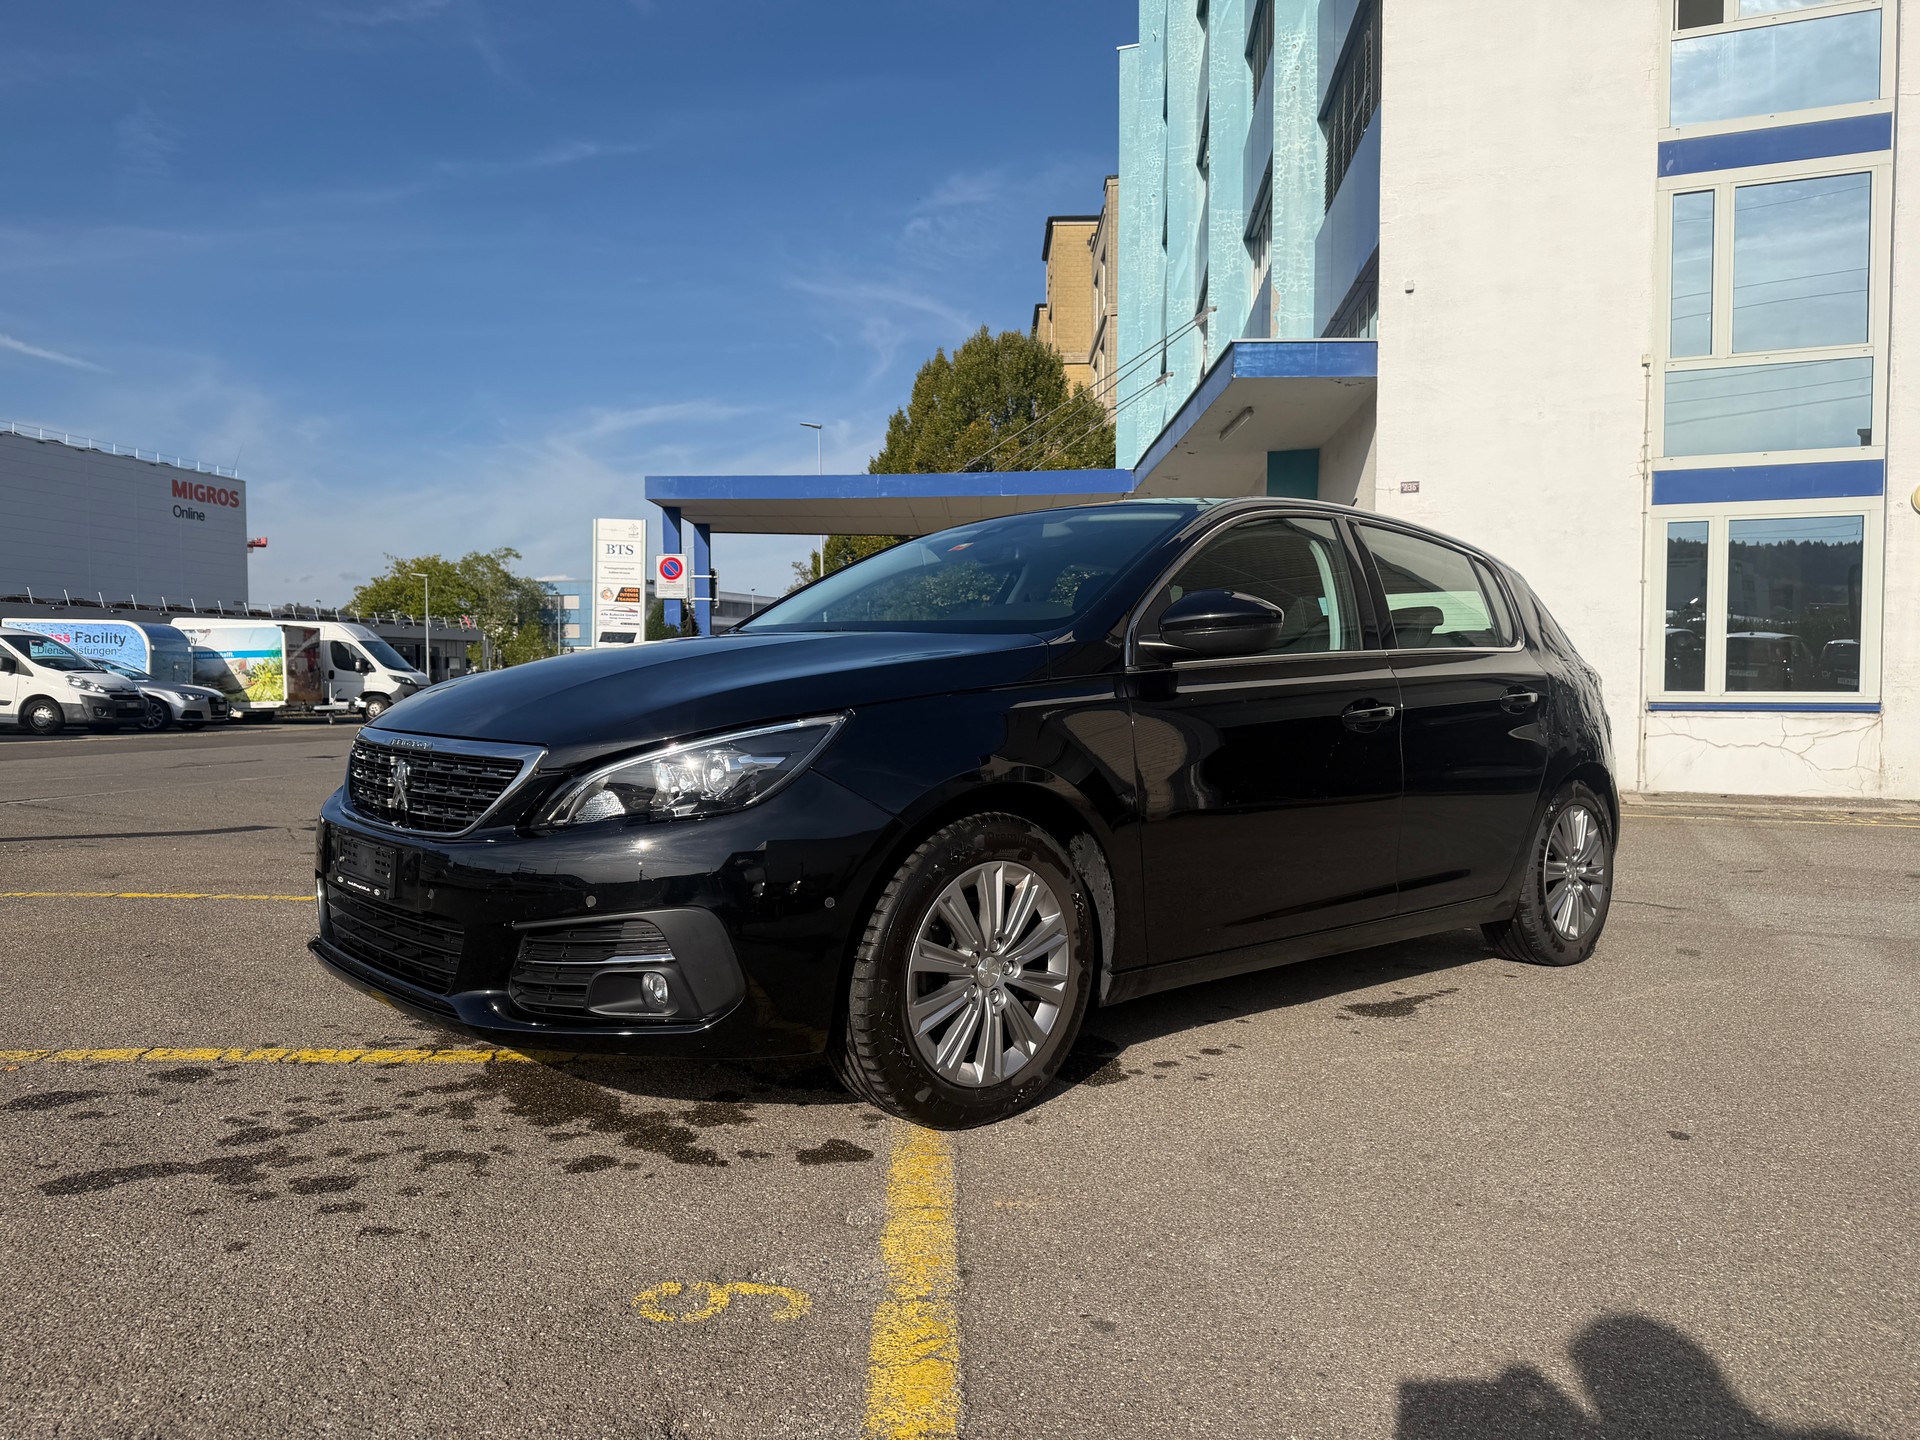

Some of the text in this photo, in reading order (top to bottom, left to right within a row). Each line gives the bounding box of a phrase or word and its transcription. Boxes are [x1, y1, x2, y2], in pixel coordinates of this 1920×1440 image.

[171, 479, 240, 508] MIGROS
[172, 504, 205, 522] Online
[606, 543, 634, 556] BTS
[75, 631, 127, 647] Facility
